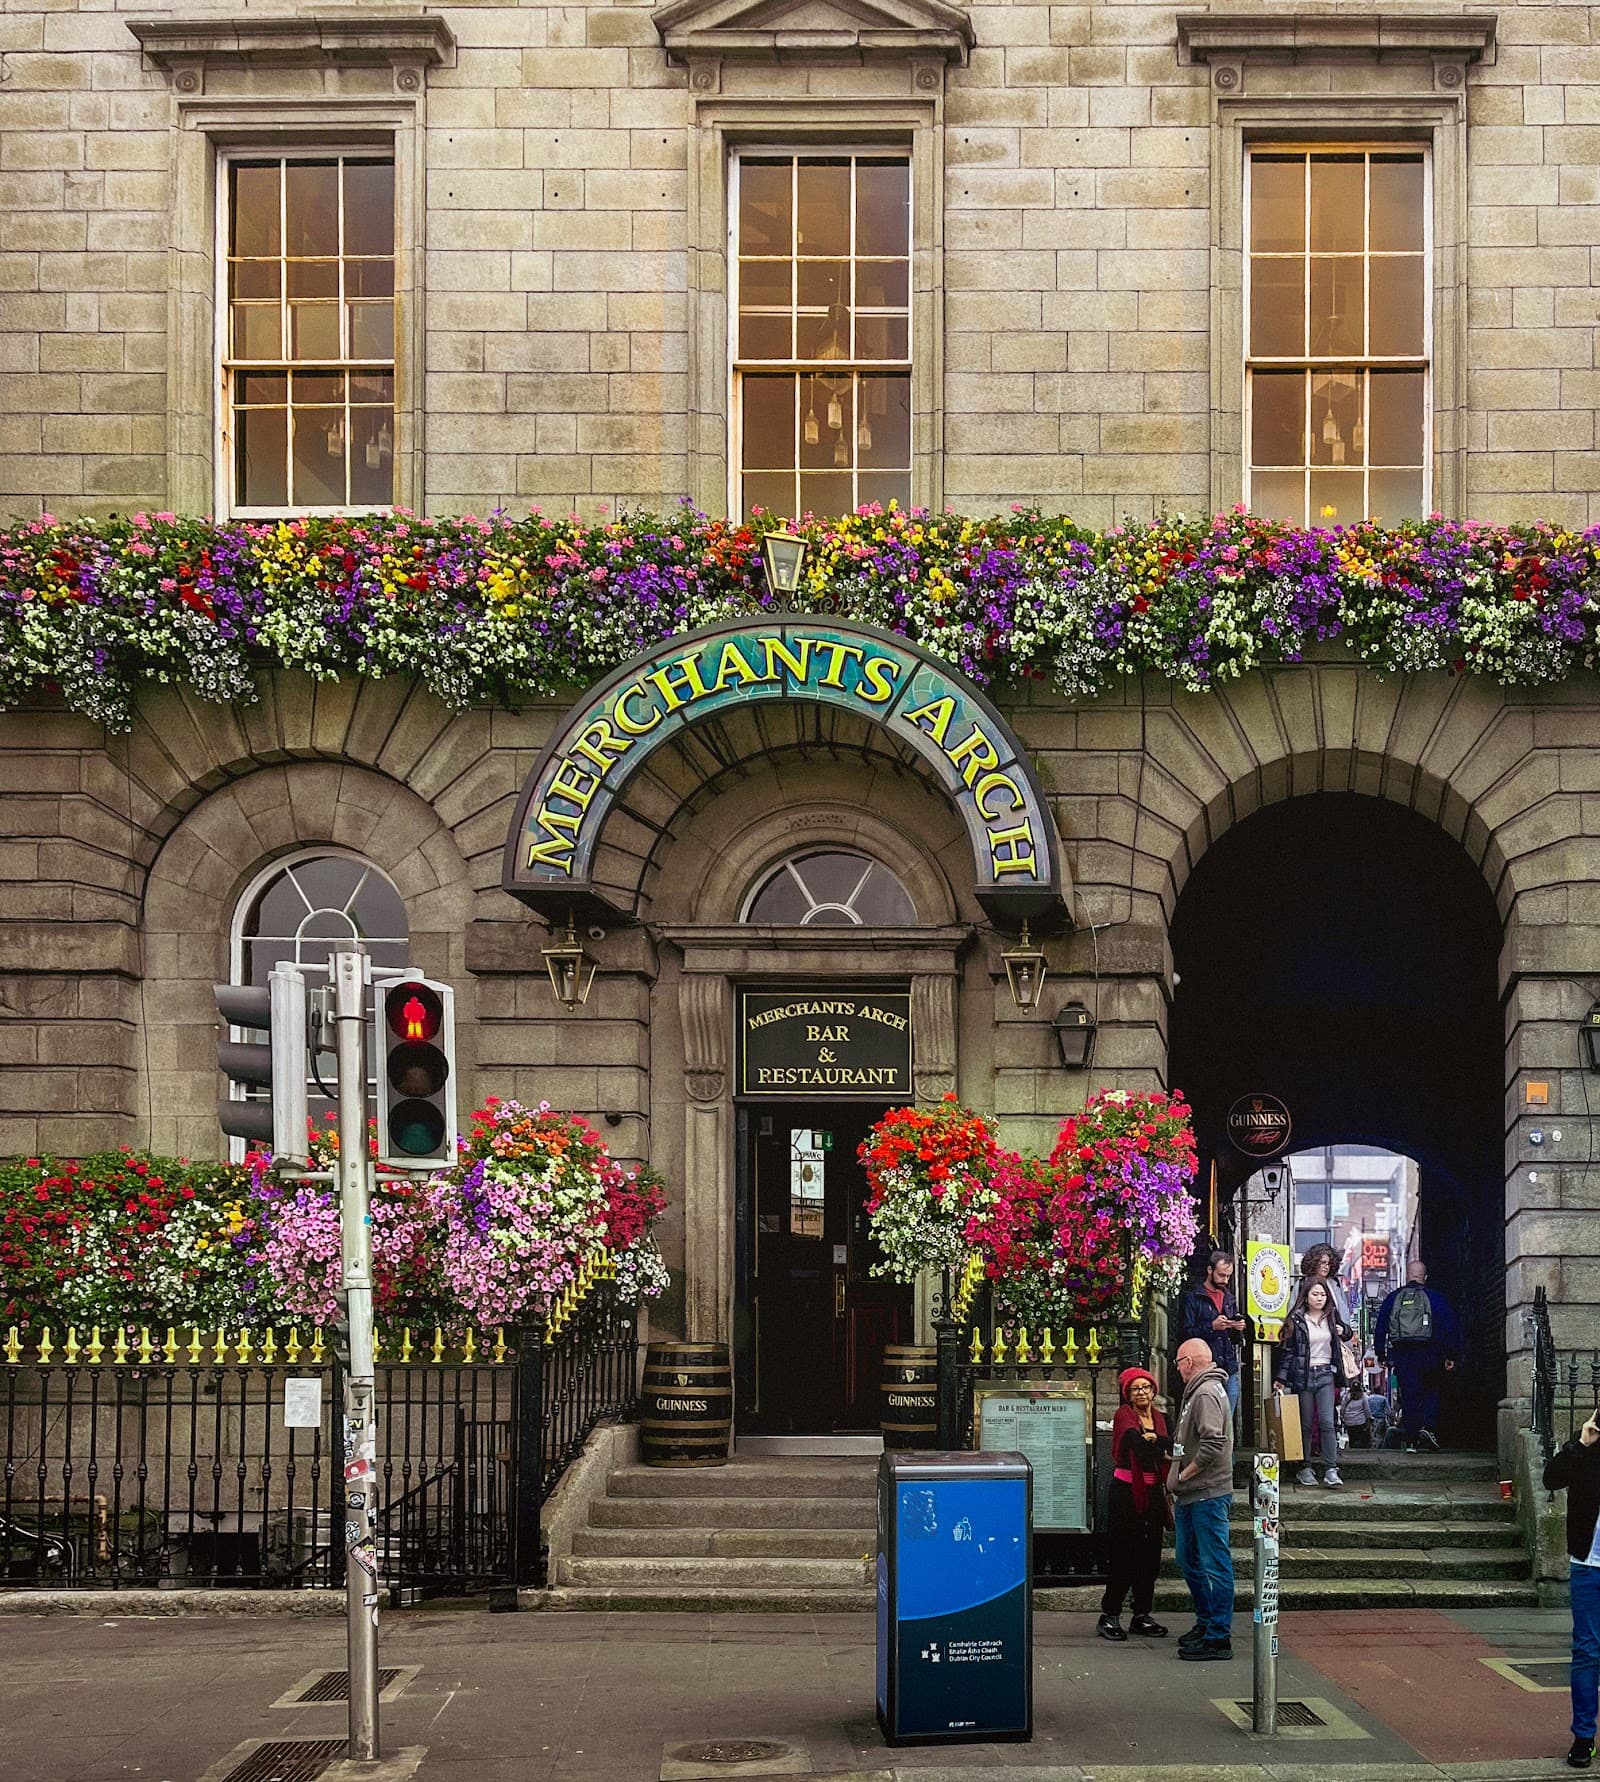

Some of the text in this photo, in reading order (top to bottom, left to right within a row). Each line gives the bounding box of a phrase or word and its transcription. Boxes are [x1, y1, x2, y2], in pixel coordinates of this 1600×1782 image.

[527, 636, 1037, 882] MERCHANTS ARCH
[747, 1001, 908, 1032] MERCHANTS ARCH
[805, 1025, 850, 1042] BAR
[817, 1046, 838, 1063] &
[757, 1067, 898, 1085] RESTAURANT
[1230, 1113, 1287, 1127] GUINNESS
[1363, 1244, 1388, 1256] OLD
[1362, 1255, 1388, 1267] MILL
[656, 1397, 707, 1412] GUINNESS
[888, 1393, 935, 1408] GUINNESS
